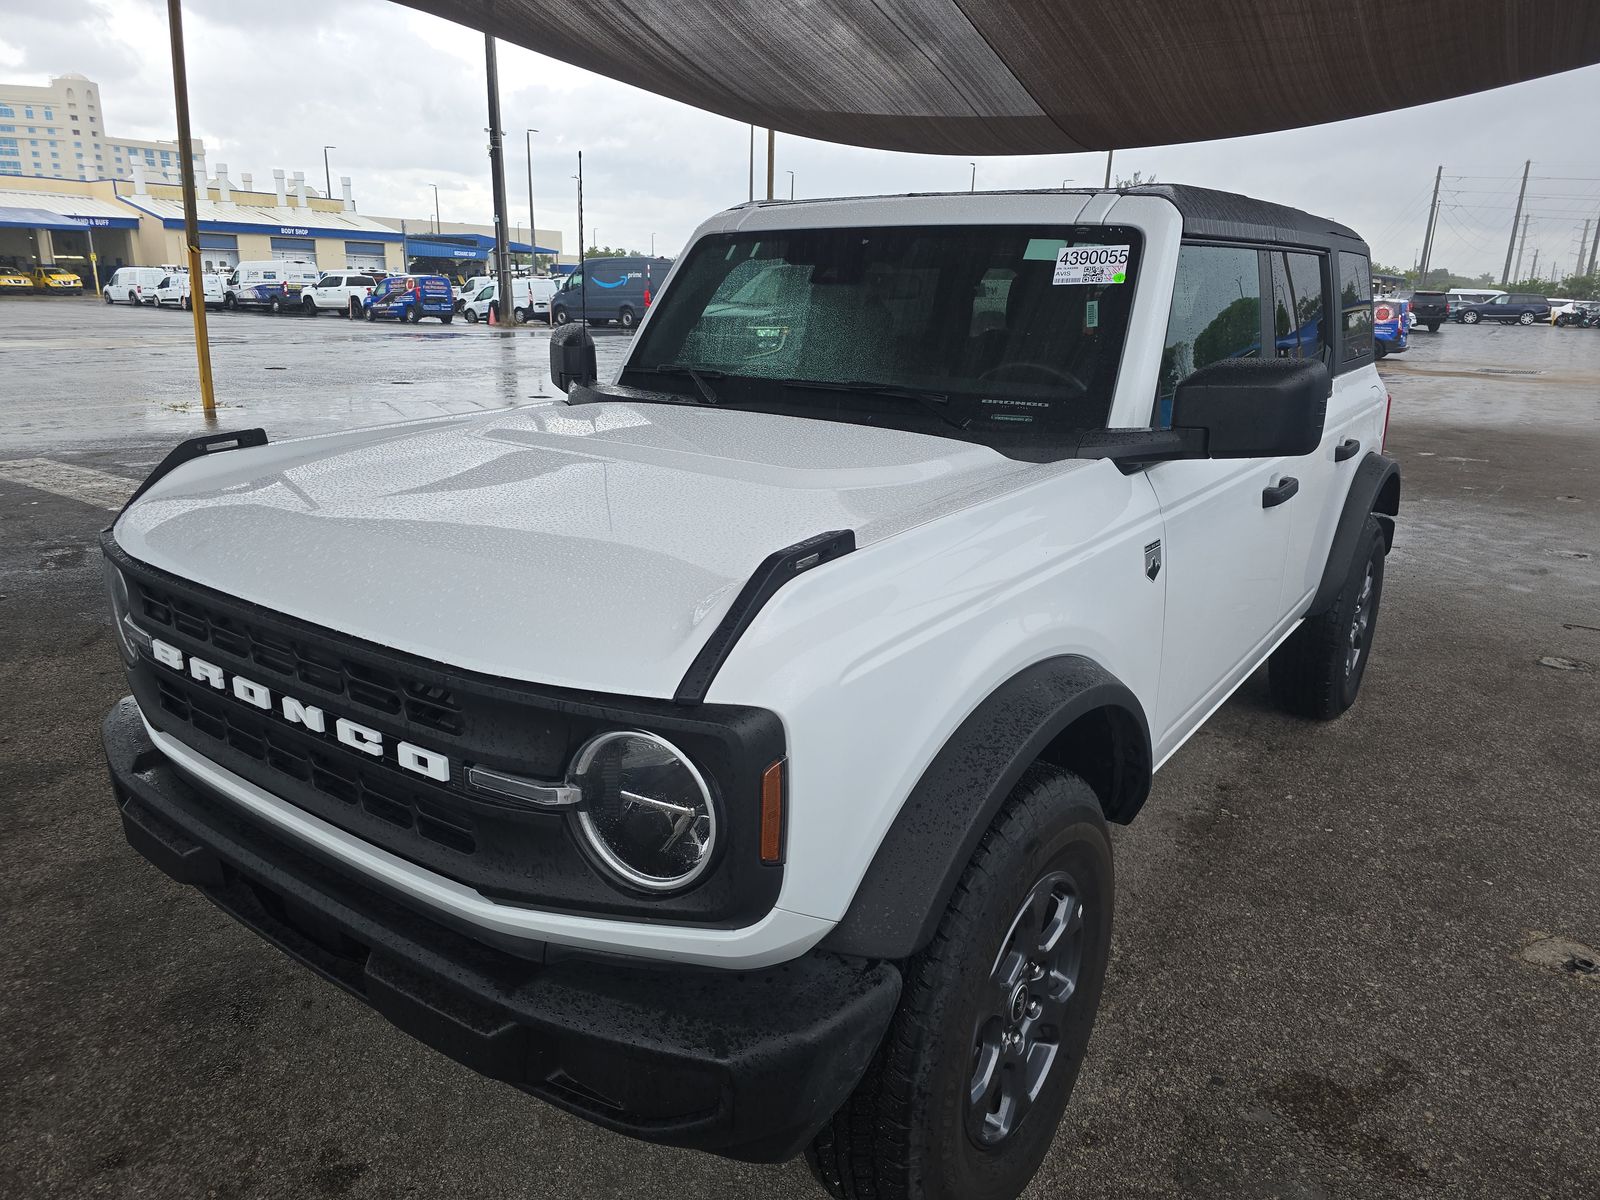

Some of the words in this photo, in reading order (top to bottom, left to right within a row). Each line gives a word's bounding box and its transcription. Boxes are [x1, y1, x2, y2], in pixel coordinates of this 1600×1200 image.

[1060, 250, 1128, 265] 4390055
[982, 399, 1049, 407] BRONCO
[152, 638, 450, 782] BRONCO
